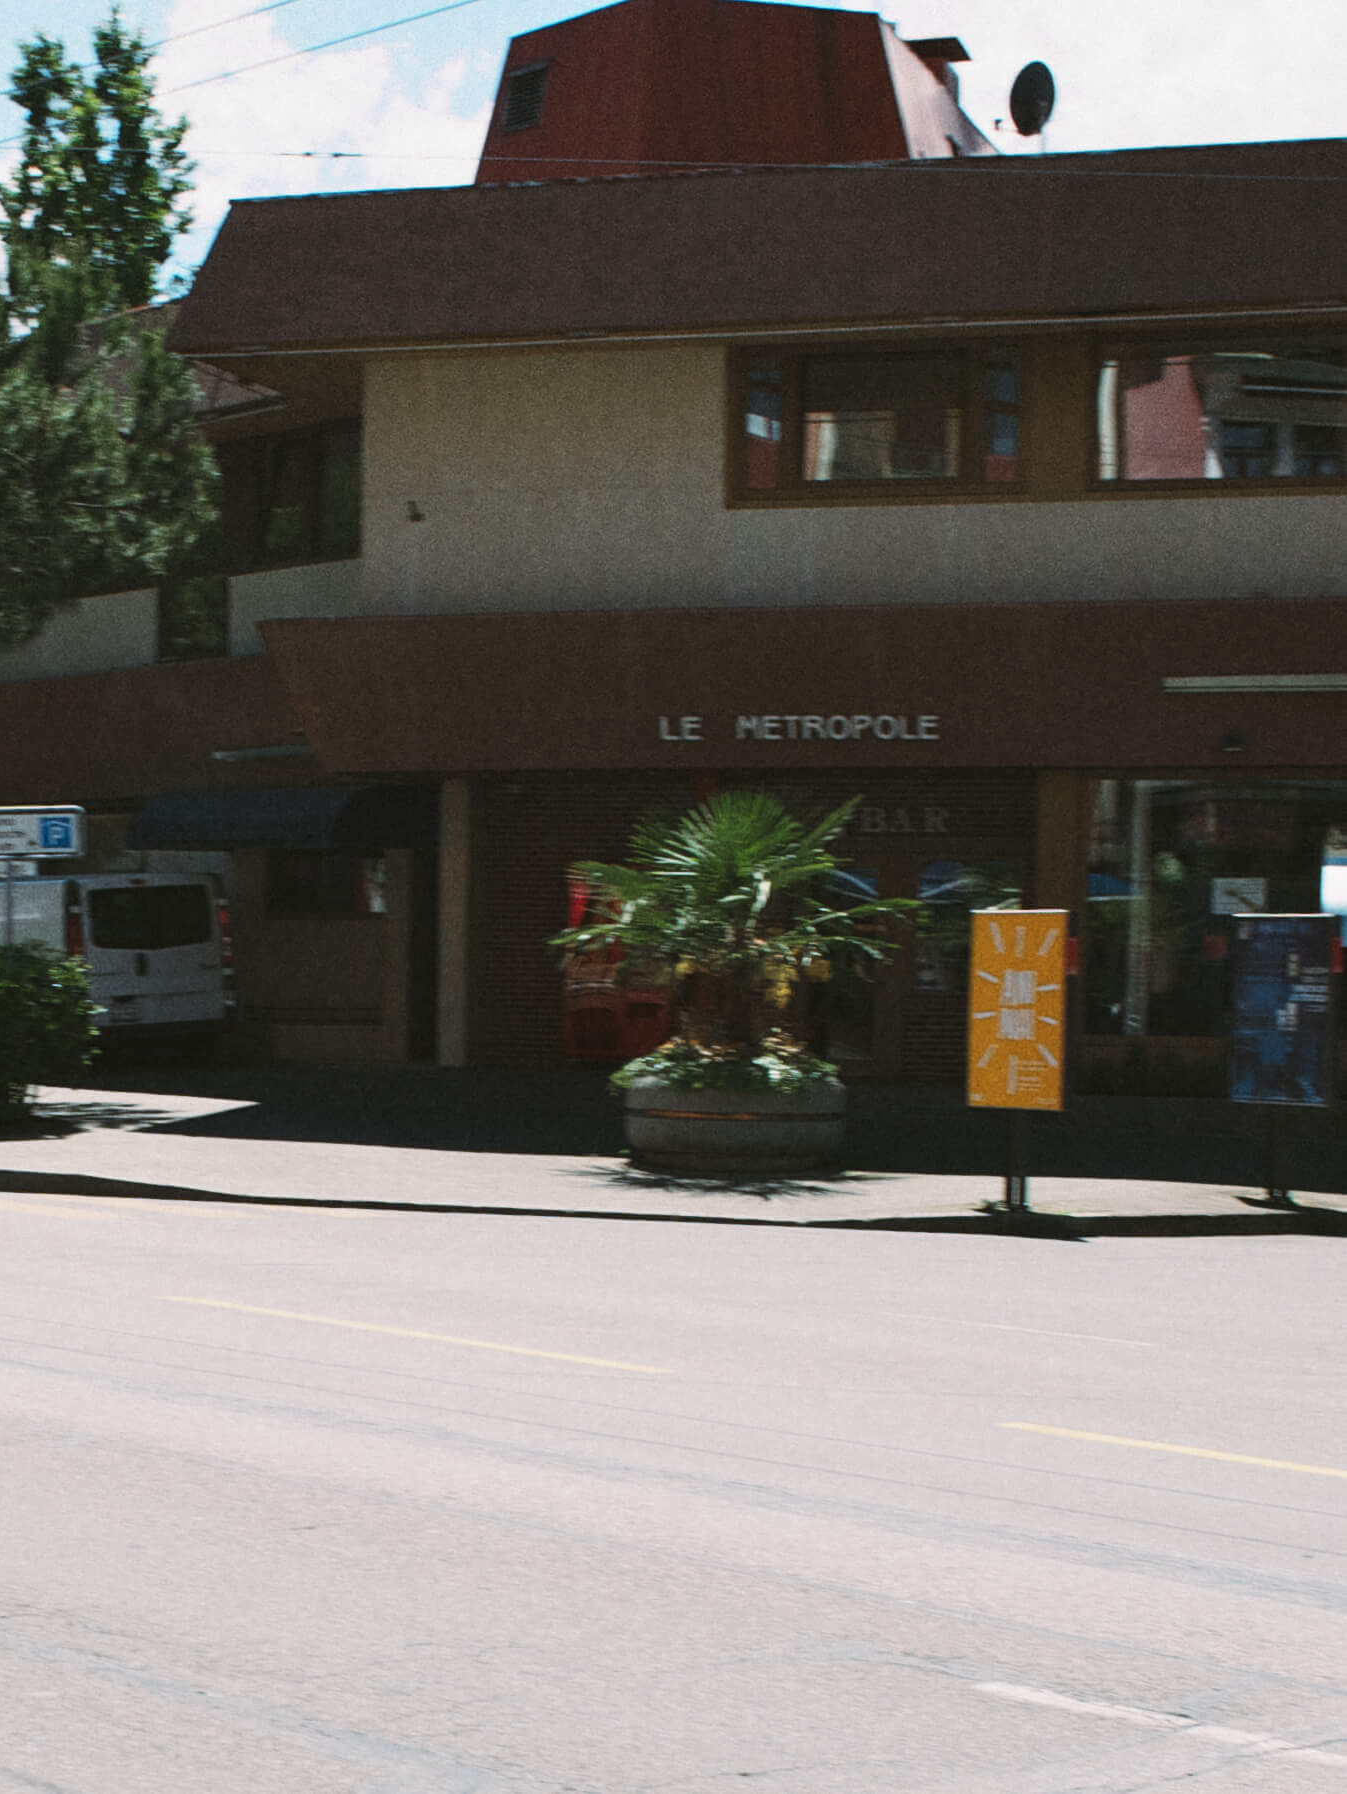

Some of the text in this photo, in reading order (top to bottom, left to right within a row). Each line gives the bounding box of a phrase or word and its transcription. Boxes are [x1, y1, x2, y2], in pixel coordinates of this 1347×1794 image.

[658, 714, 941, 741] LE METROPOLE
[858, 806, 951, 834] BAR
